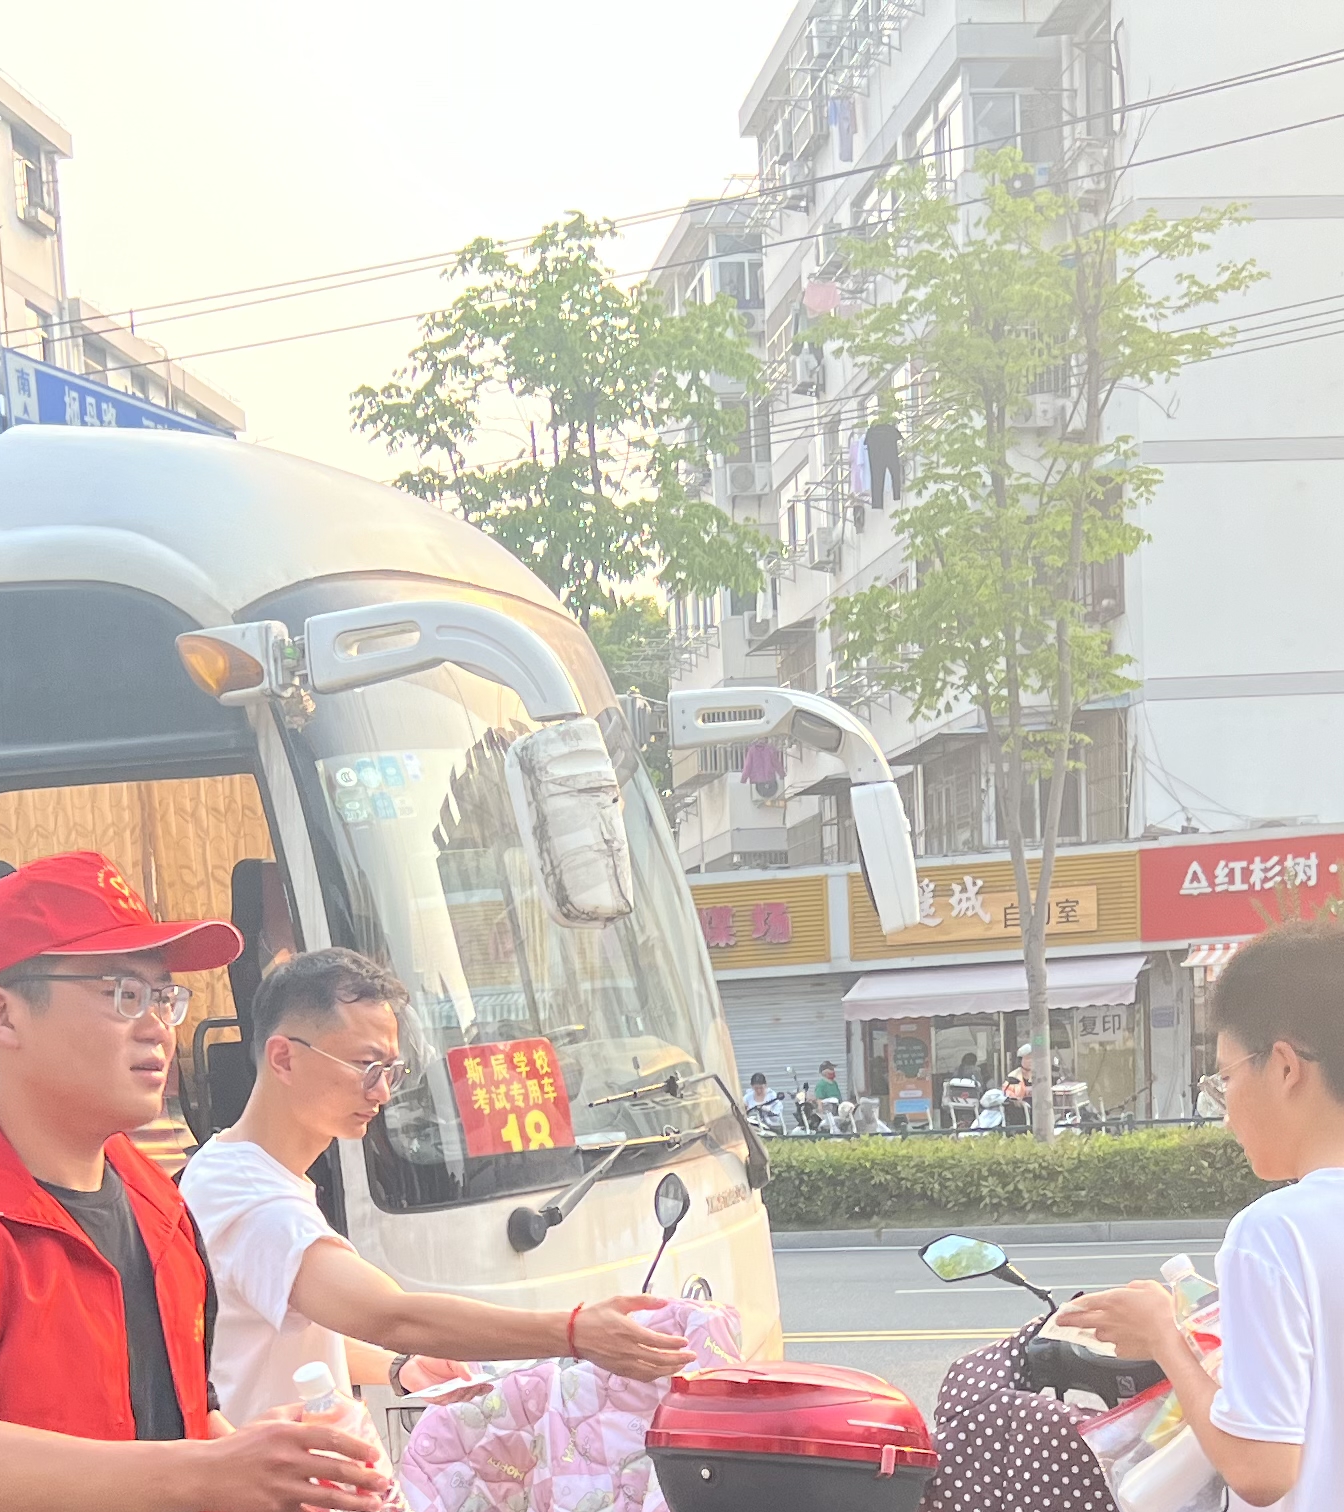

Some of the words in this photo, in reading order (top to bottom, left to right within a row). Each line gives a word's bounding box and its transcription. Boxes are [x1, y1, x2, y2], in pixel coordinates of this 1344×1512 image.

[16, 367, 31, 398] 南
[1004, 897, 1081, 929] 自室
[1078, 1012, 1122, 1037] 复印
[464, 1047, 552, 1085] 斯辰学校
[472, 1076, 558, 1115] 考试专用车
[500, 1109, 555, 1152] 18
